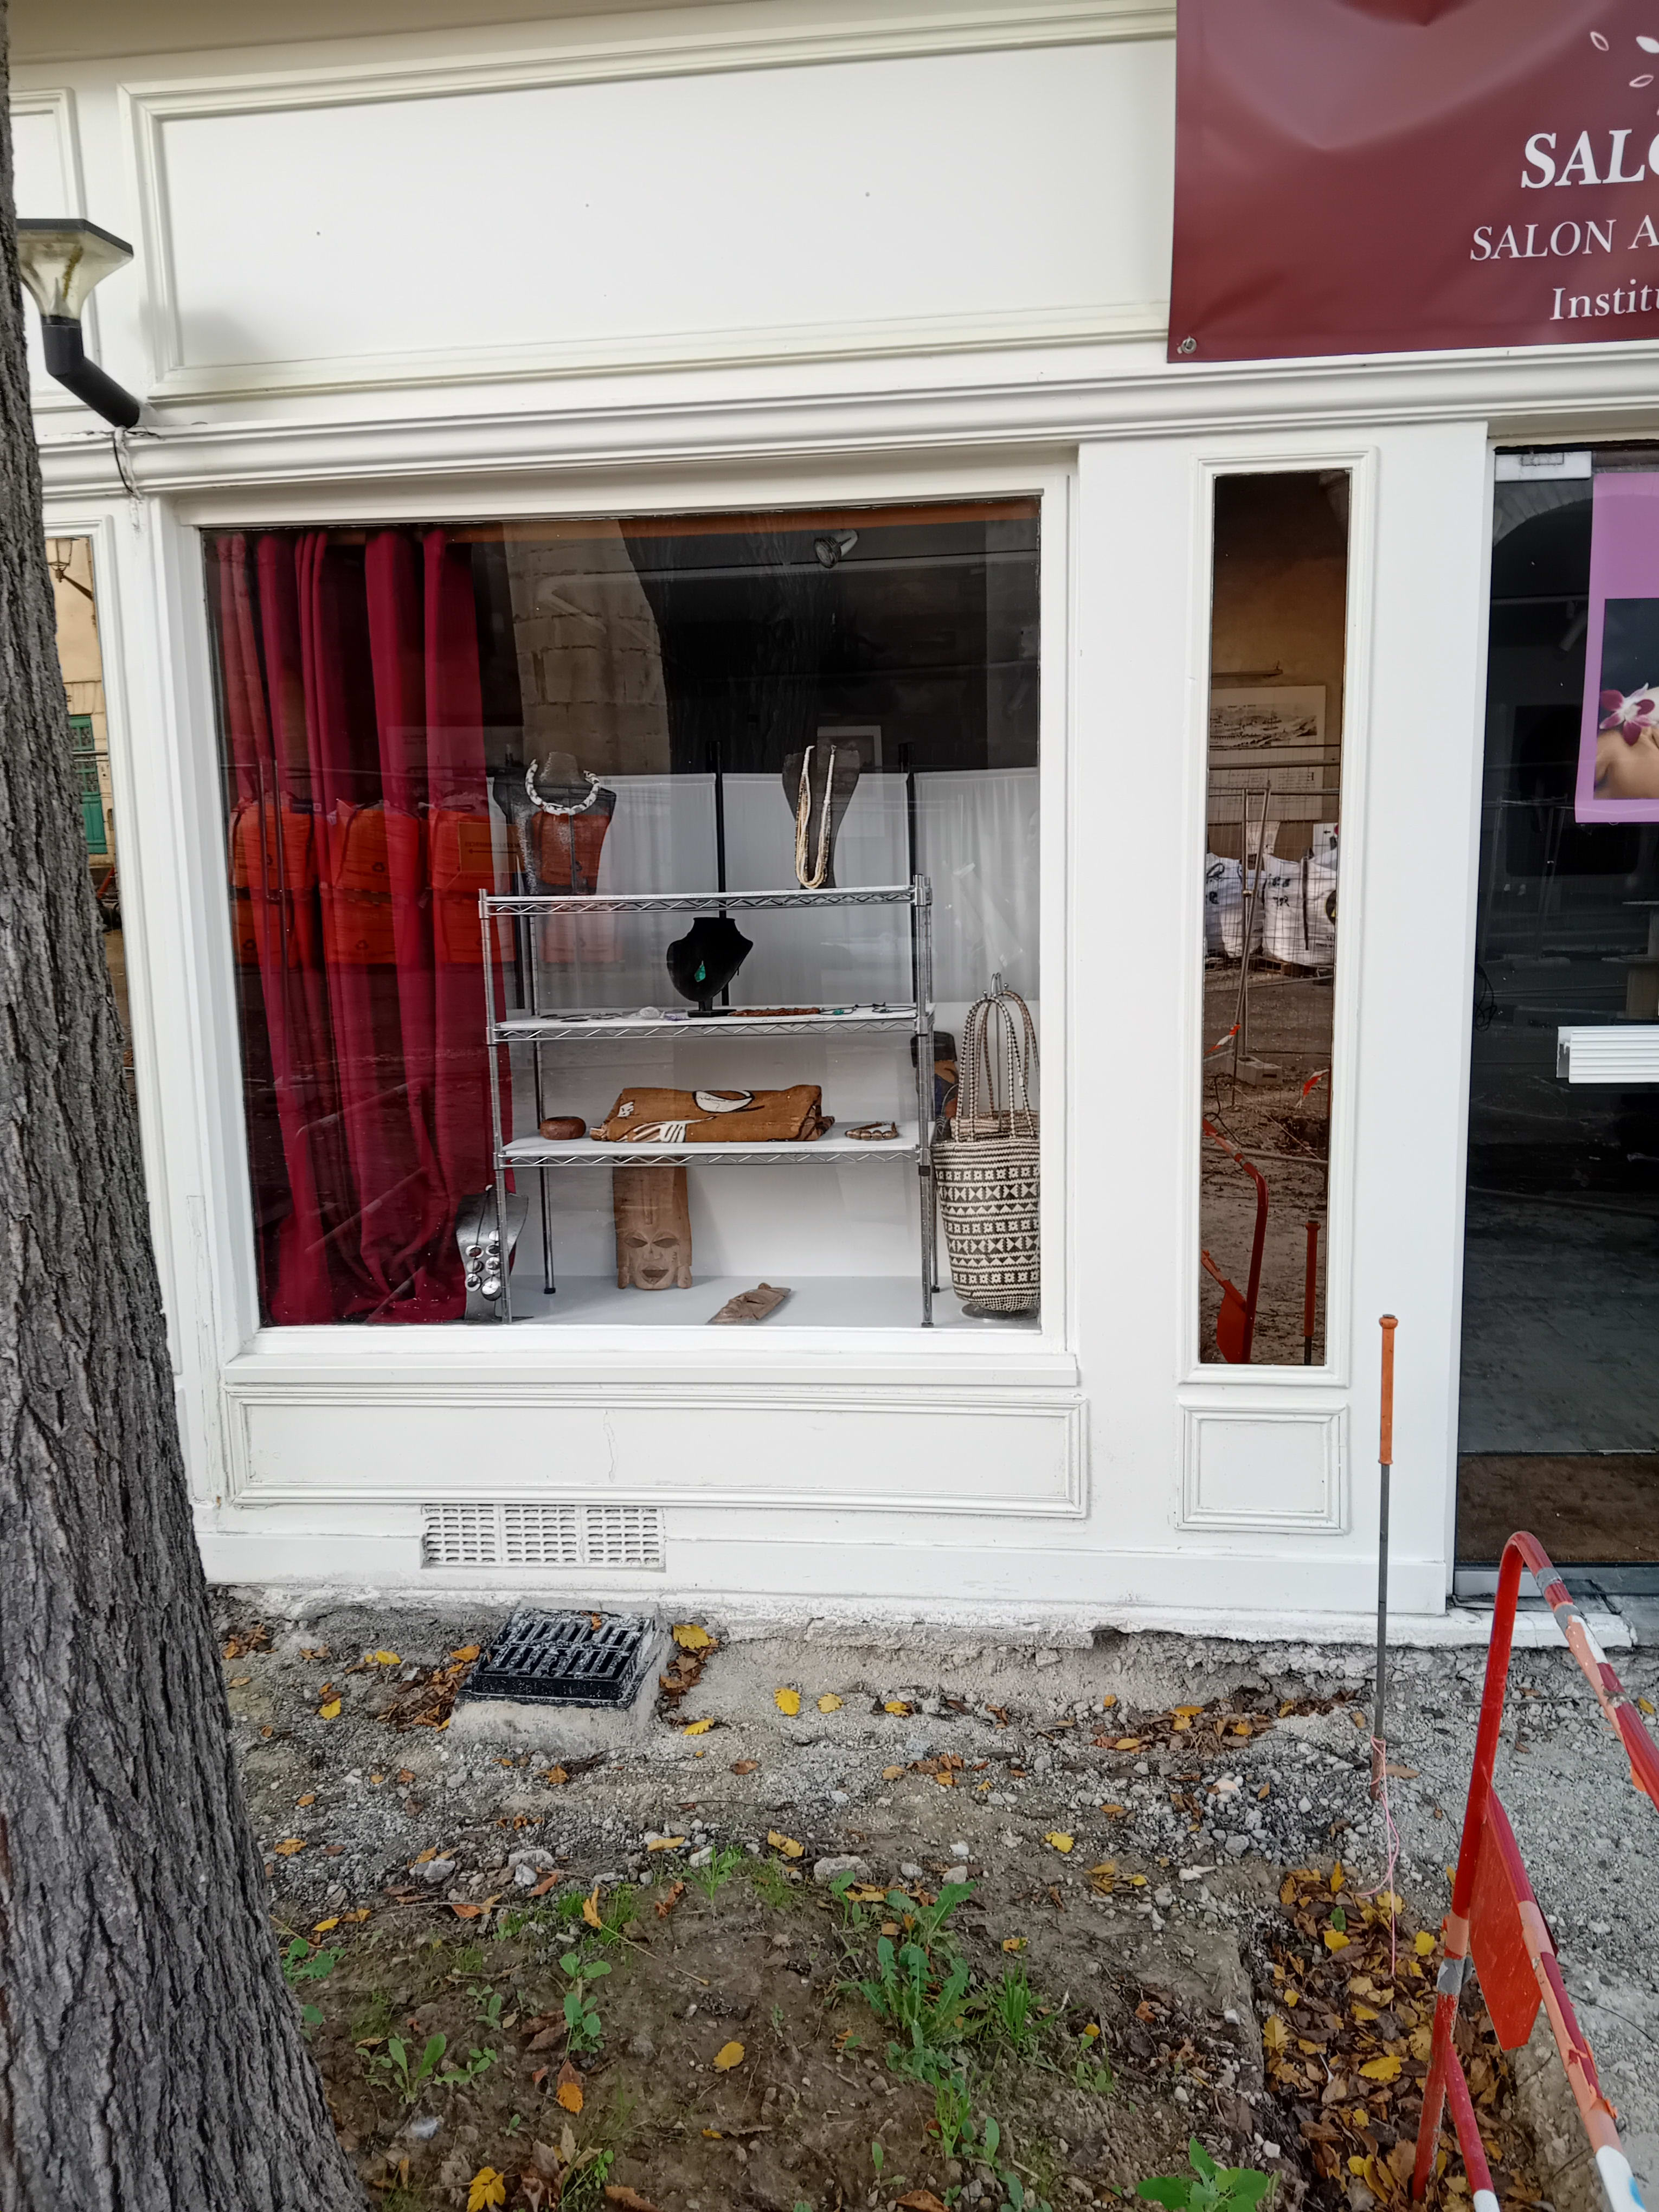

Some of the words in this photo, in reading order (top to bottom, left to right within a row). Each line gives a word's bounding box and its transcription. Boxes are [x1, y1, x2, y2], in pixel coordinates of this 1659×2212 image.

[1521, 129, 1659, 189] SAL
[1470, 219, 1617, 261] SALON
[1549, 279, 1659, 320] Instit
